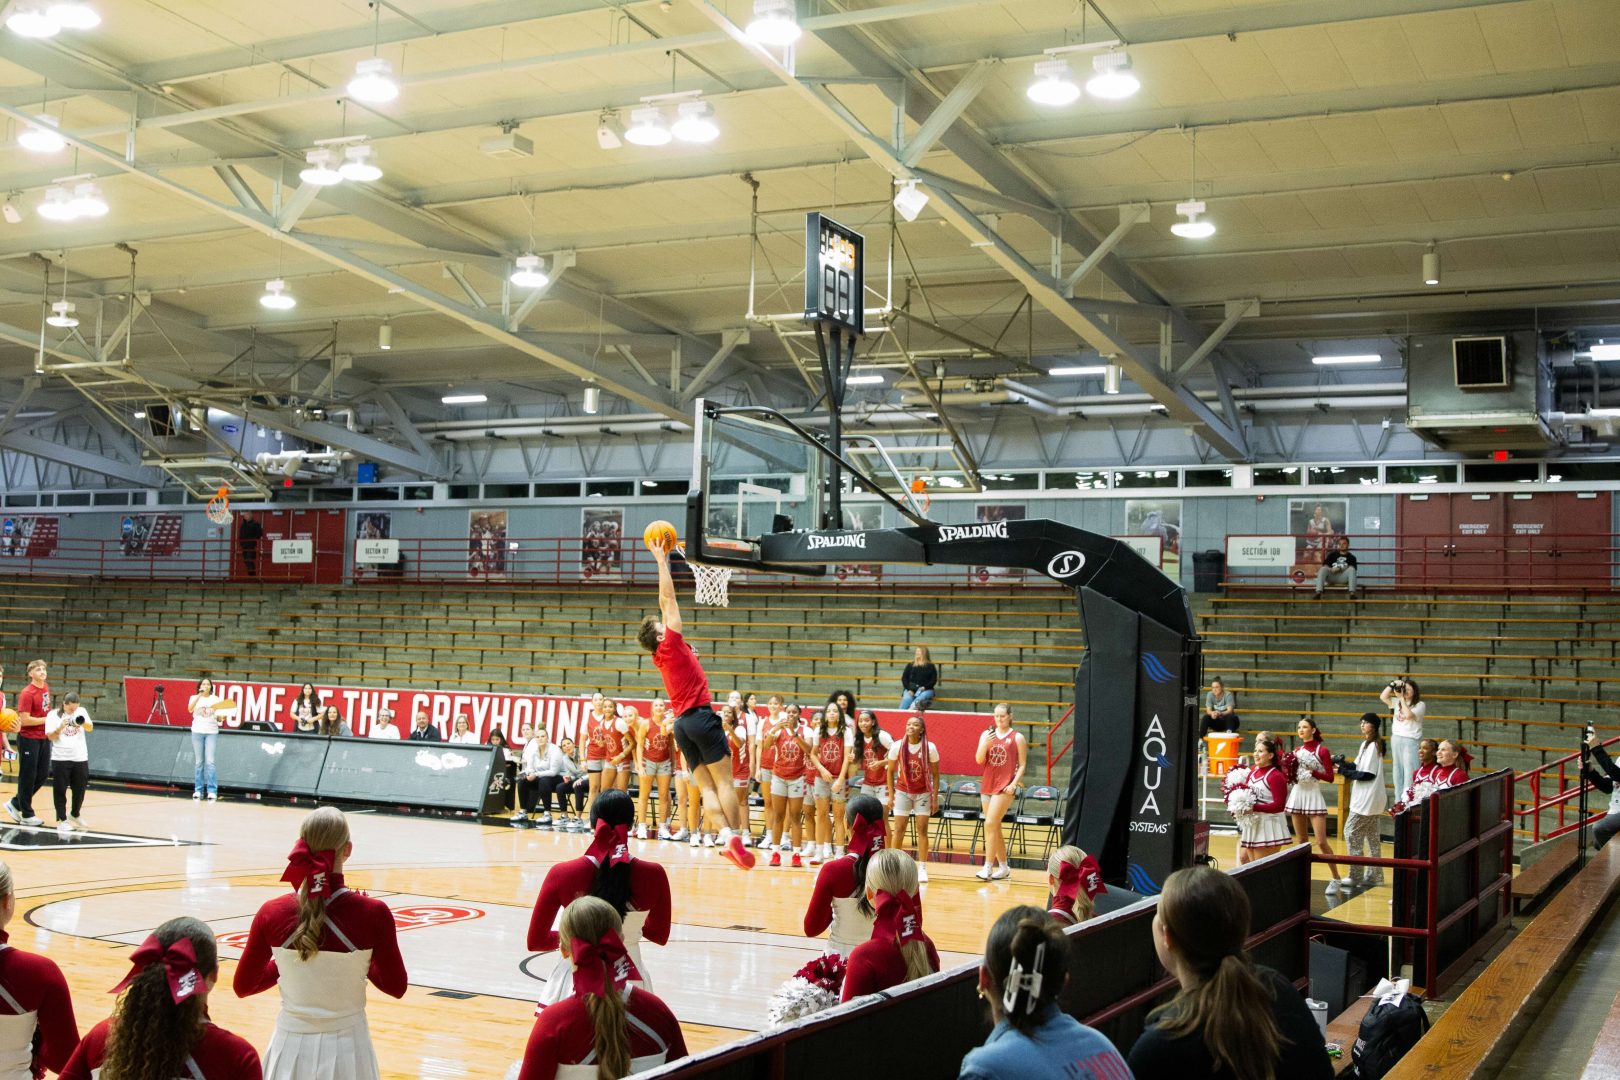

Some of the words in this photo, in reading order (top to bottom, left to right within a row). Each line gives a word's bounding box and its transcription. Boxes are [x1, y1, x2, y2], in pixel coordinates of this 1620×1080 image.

[807, 532, 866, 550] SPALDING
[938, 521, 1008, 543] SPALDING
[1242, 547, 1268, 556] SECTION
[343, 690, 399, 736] THE
[1139, 713, 1169, 816] AQUA
